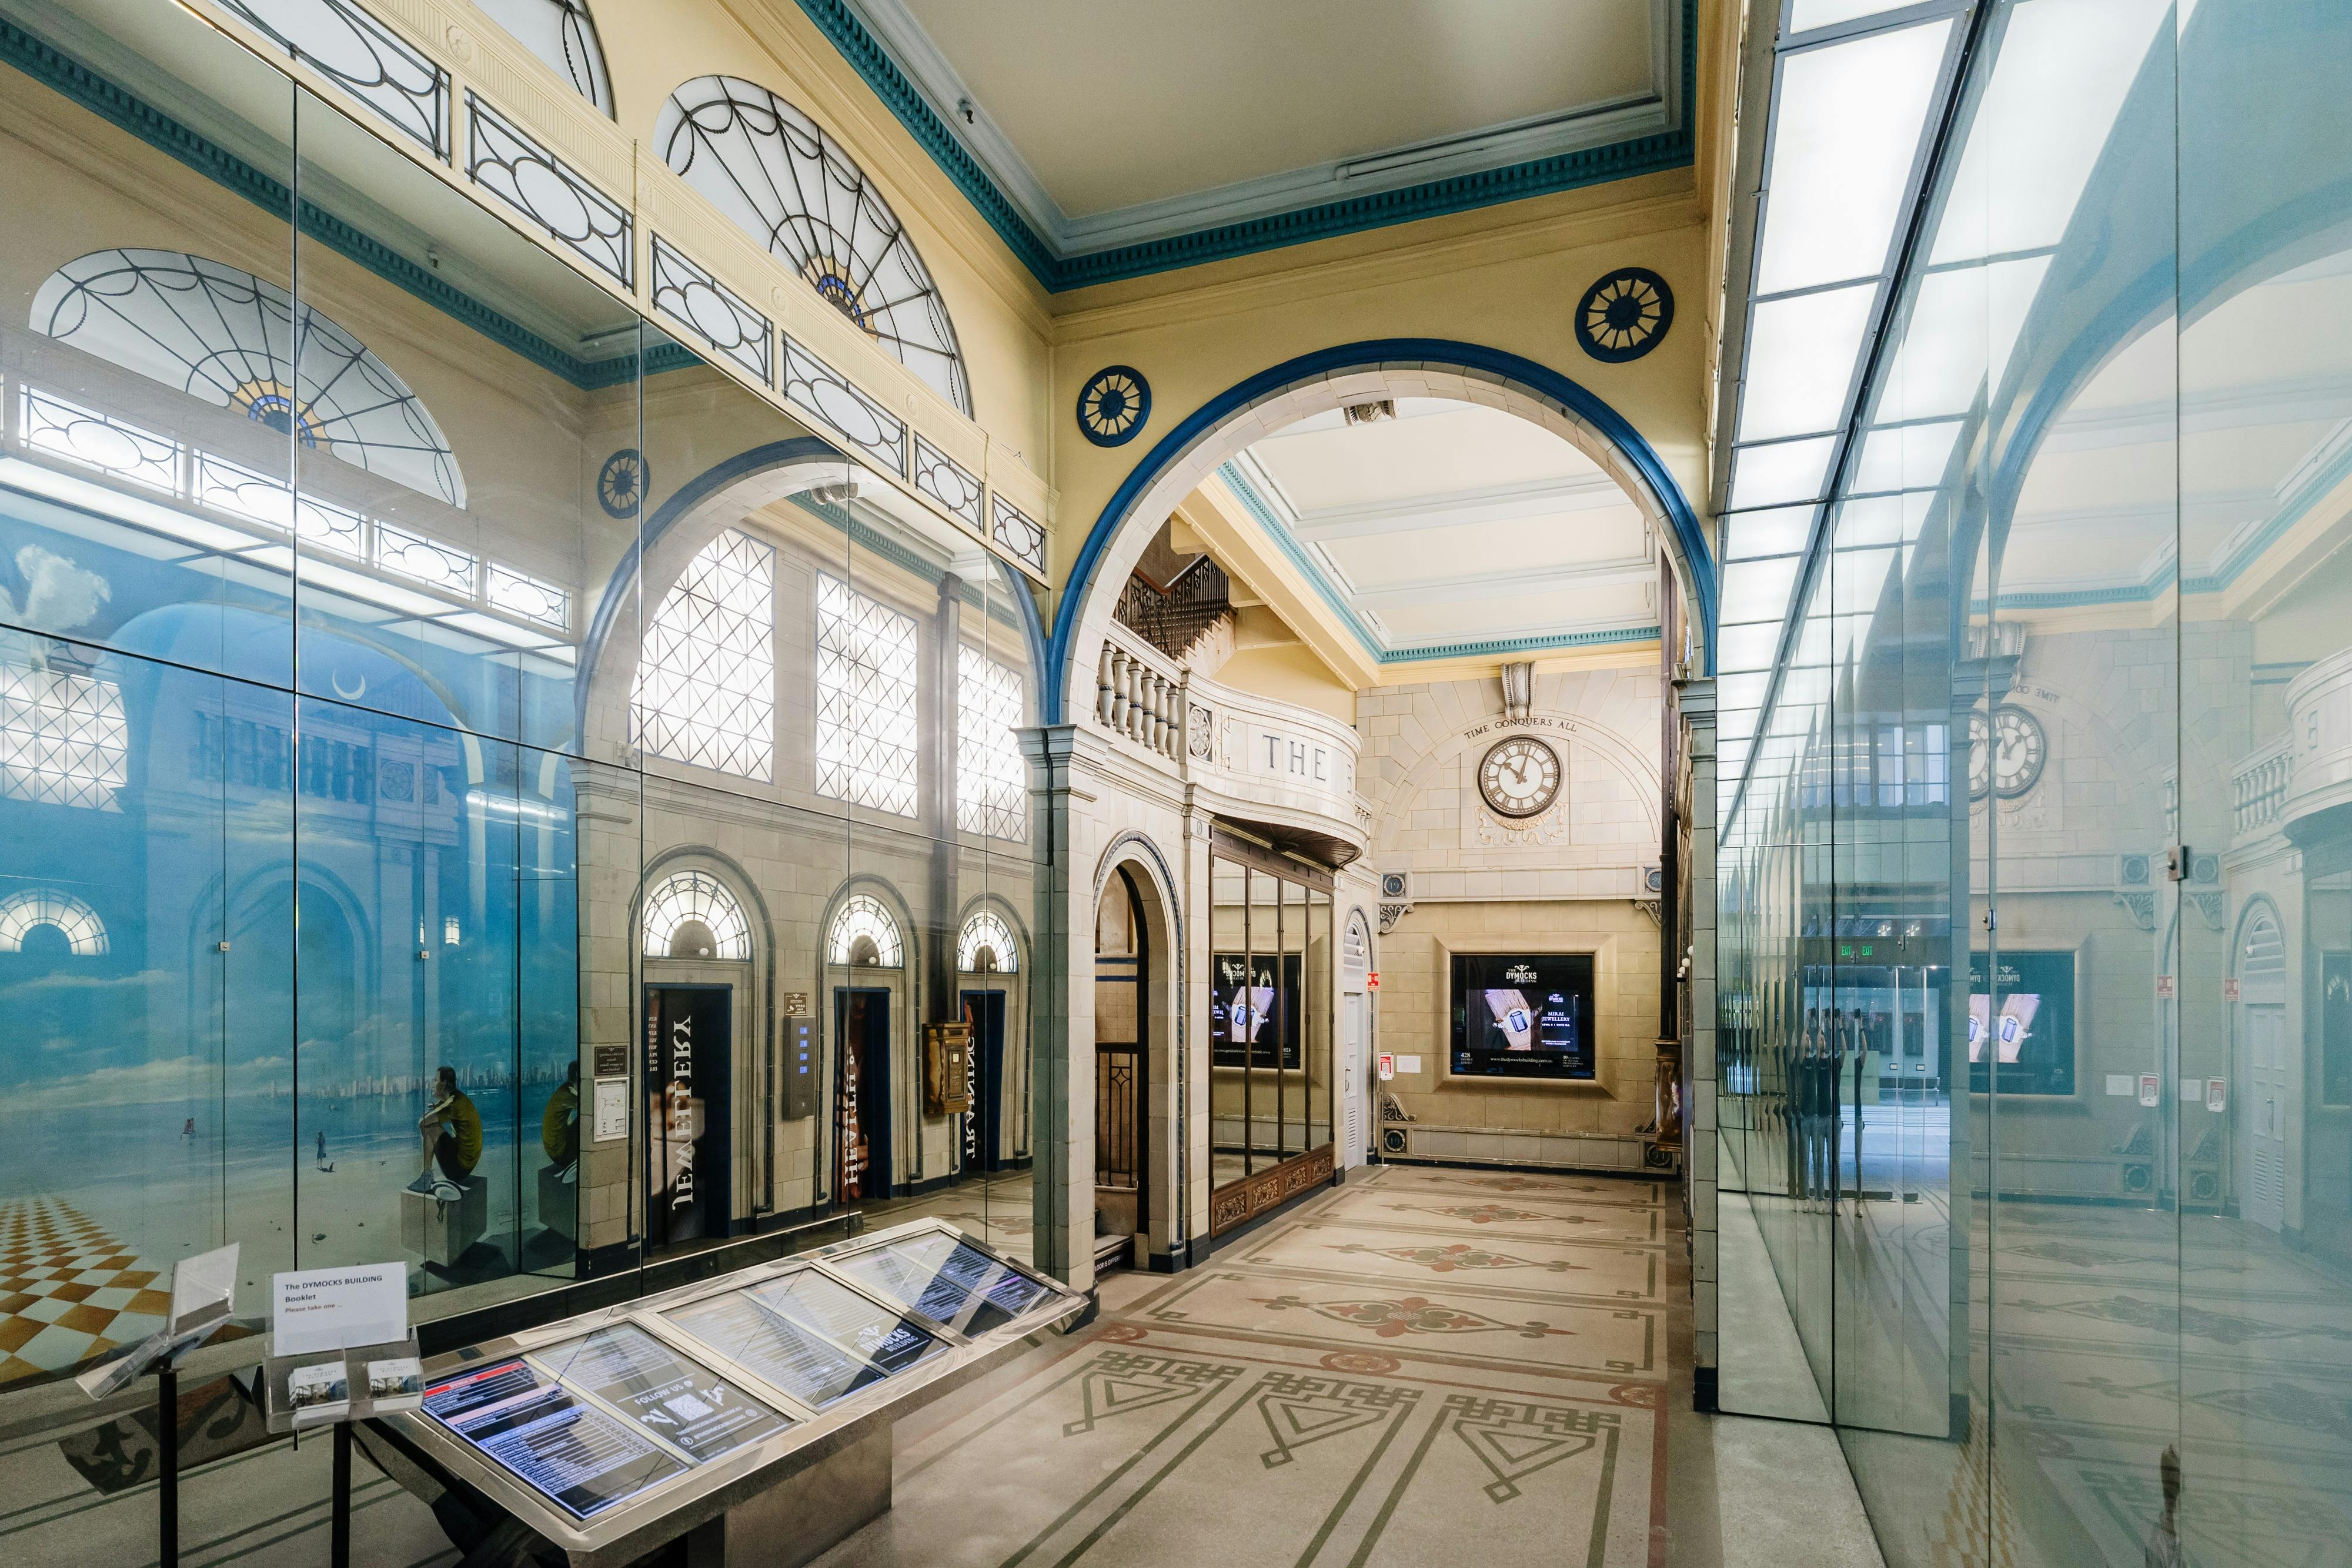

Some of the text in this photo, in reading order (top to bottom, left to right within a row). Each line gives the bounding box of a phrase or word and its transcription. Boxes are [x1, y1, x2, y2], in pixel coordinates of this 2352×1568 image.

[1464, 718, 1577, 739] TIME CONQUERS ALL
[1262, 734, 1326, 781] THE
[1389, 882, 1399, 890] 19
[1862, 946, 1872, 955] EXIT
[302, 1279, 343, 1289] DYMOCKS
[345, 1275, 383, 1285] BUILDING
[285, 1294, 317, 1303] Booklet
[859, 1328, 911, 1353] DYMOCKS
[885, 1335, 918, 1352] BUILDING
[634, 1383, 684, 1406] FOLLOW US
